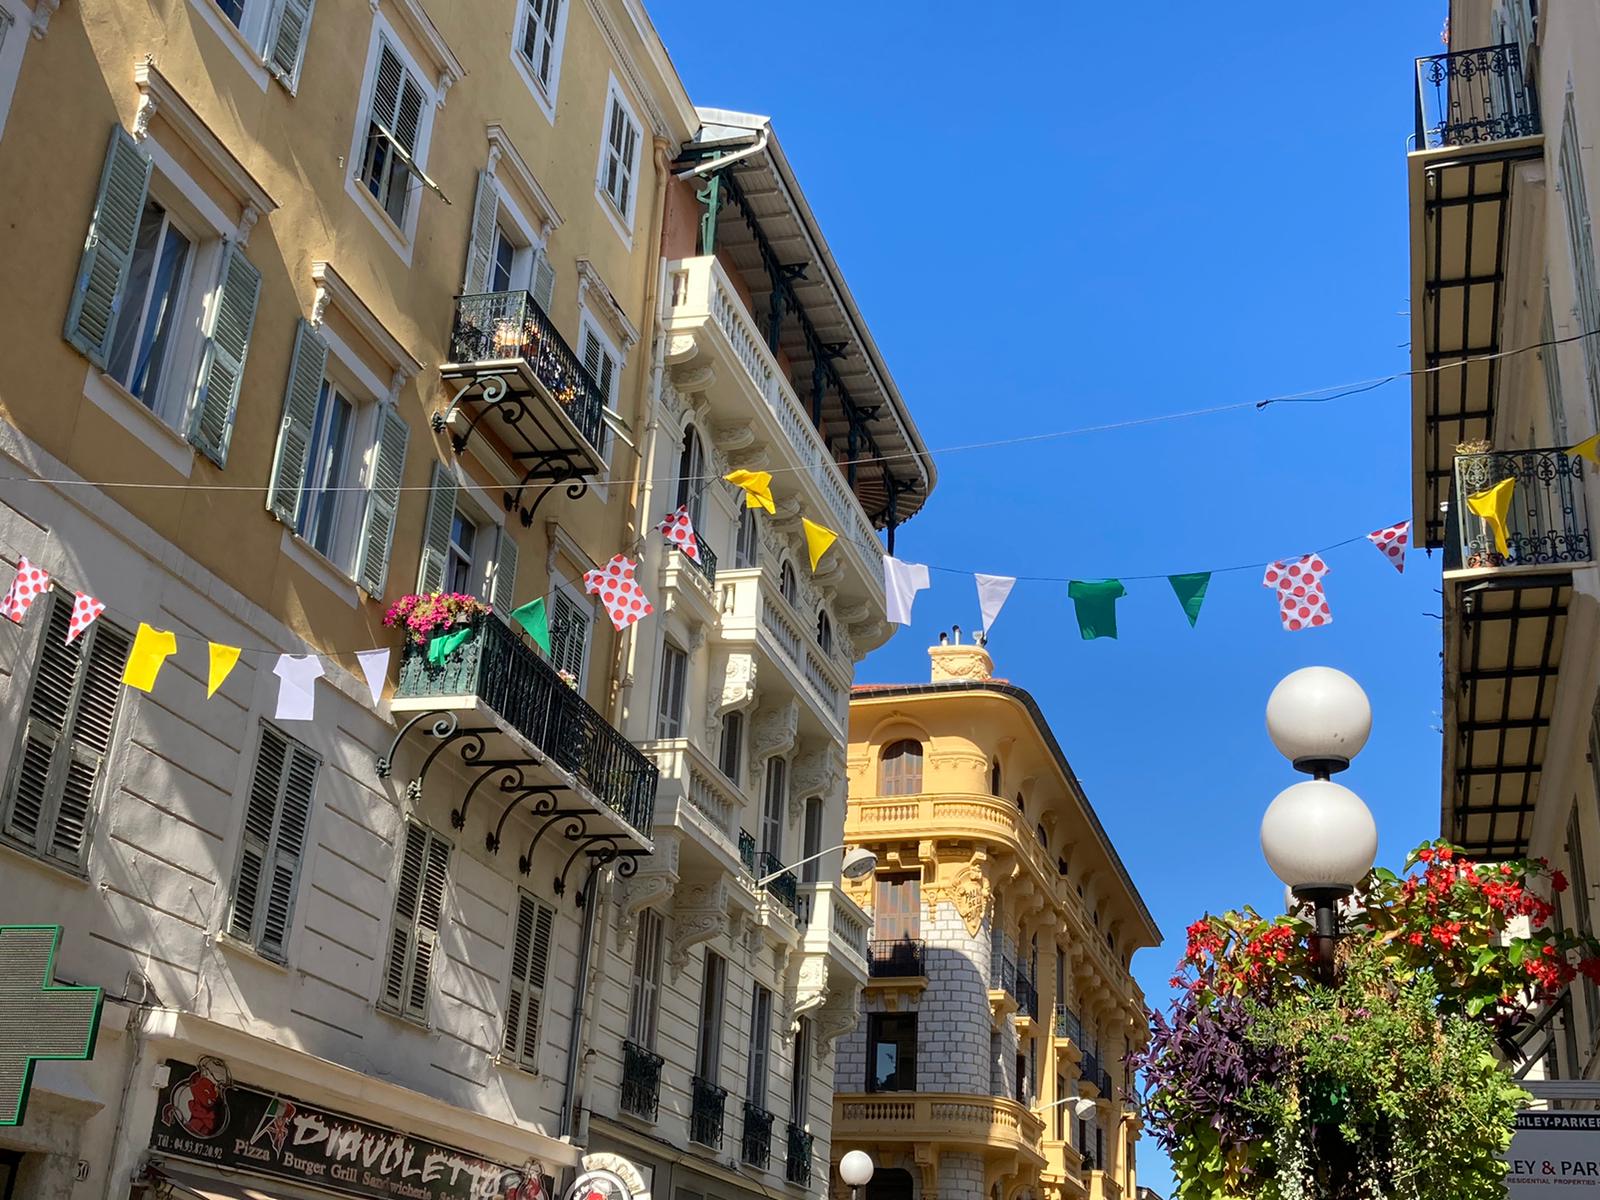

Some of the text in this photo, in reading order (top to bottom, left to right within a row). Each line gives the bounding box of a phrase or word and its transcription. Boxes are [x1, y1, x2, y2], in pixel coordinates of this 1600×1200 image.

[233, 1138, 271, 1161] Pizza
[283, 1151, 327, 1176] Burger
[330, 1163, 358, 1183] Grill
[1541, 1160, 1556, 1175] &
[1561, 1161, 1600, 1177] PAR
